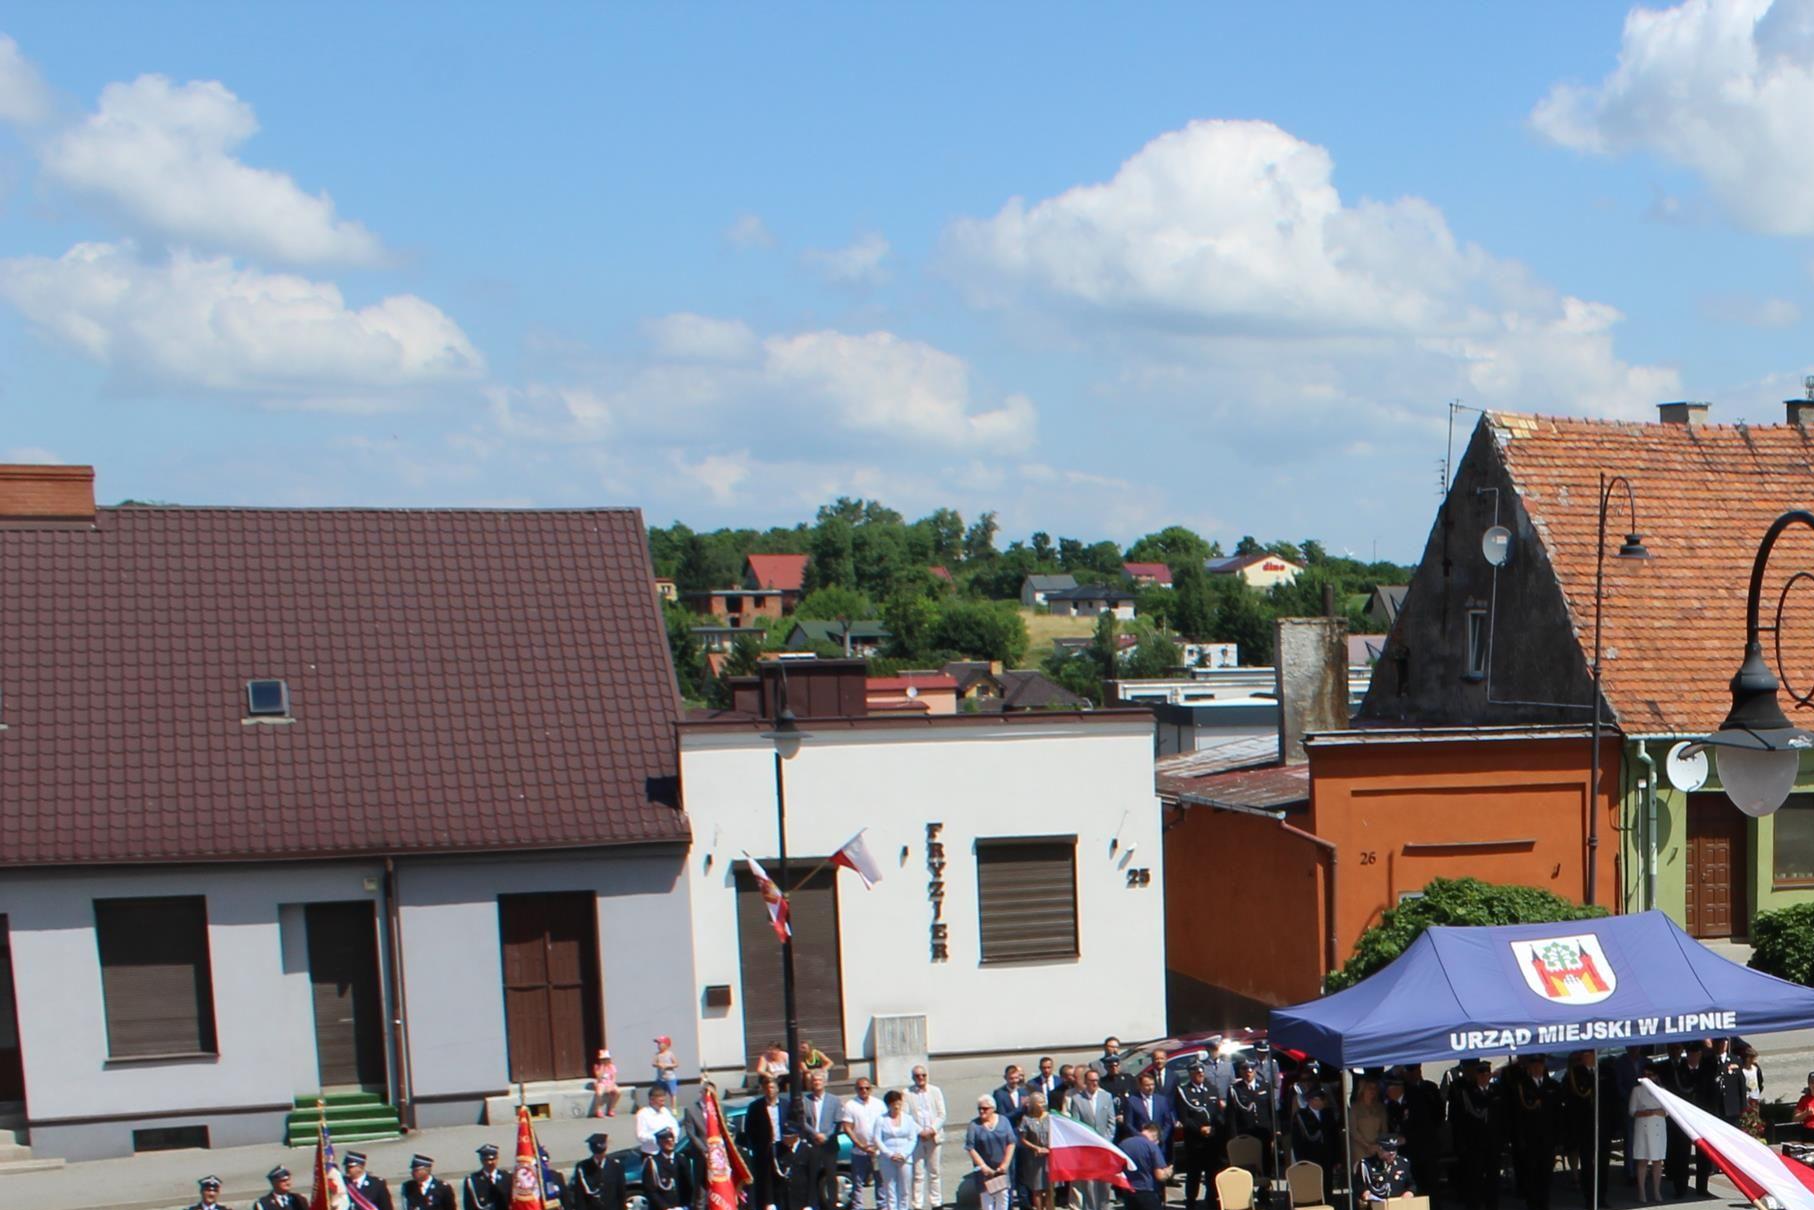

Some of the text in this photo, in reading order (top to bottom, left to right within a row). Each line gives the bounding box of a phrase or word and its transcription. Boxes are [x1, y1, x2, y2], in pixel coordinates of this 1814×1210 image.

[1360, 852, 1376, 865] 26
[926, 822, 949, 962] FRYZJER
[1127, 868, 1151, 888] 25
[1450, 1011, 1736, 1050] URZĄD MIEJSKI W LIPNIE
